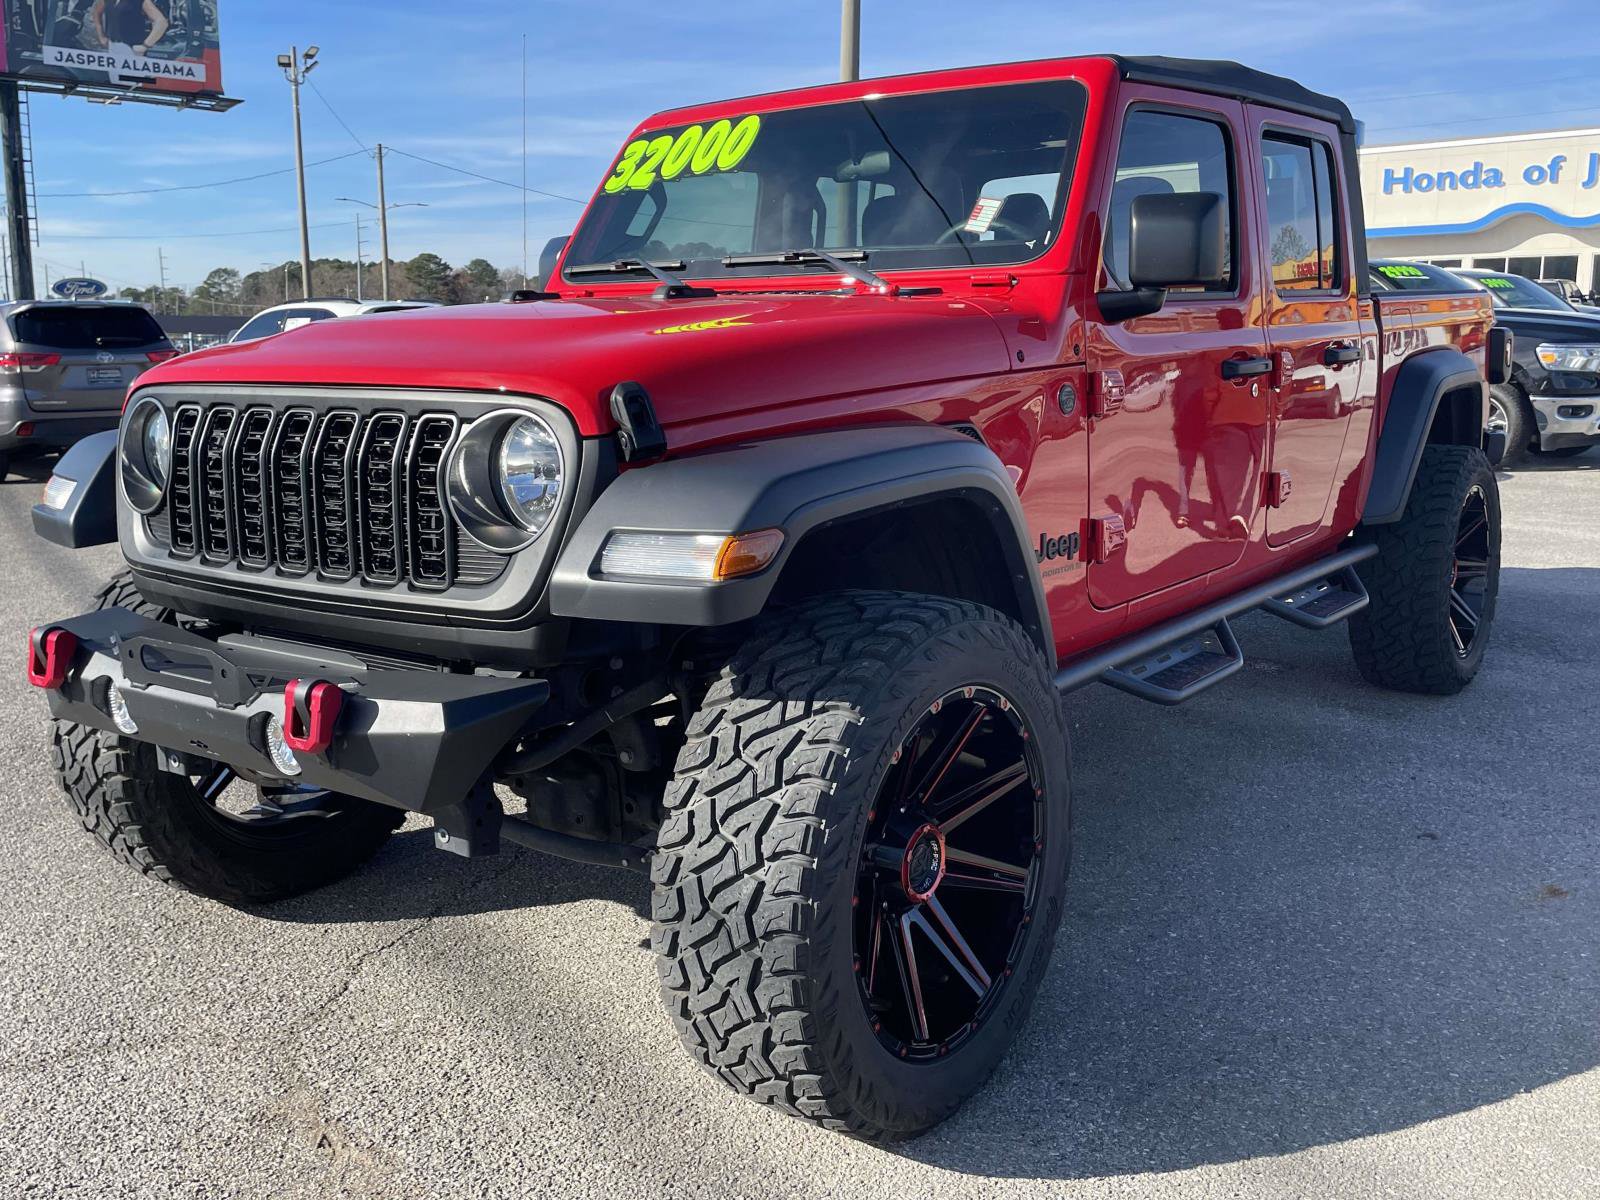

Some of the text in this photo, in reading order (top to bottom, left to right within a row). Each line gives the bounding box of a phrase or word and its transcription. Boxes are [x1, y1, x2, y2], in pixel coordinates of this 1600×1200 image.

[54, 50, 196, 78] JASPER ALABAMA
[604, 114, 761, 194] 32000
[1382, 161, 1505, 195] Honda
[1523, 155, 1567, 186] of
[63, 281, 97, 296] Ford
[1034, 531, 1080, 564] Jeep
